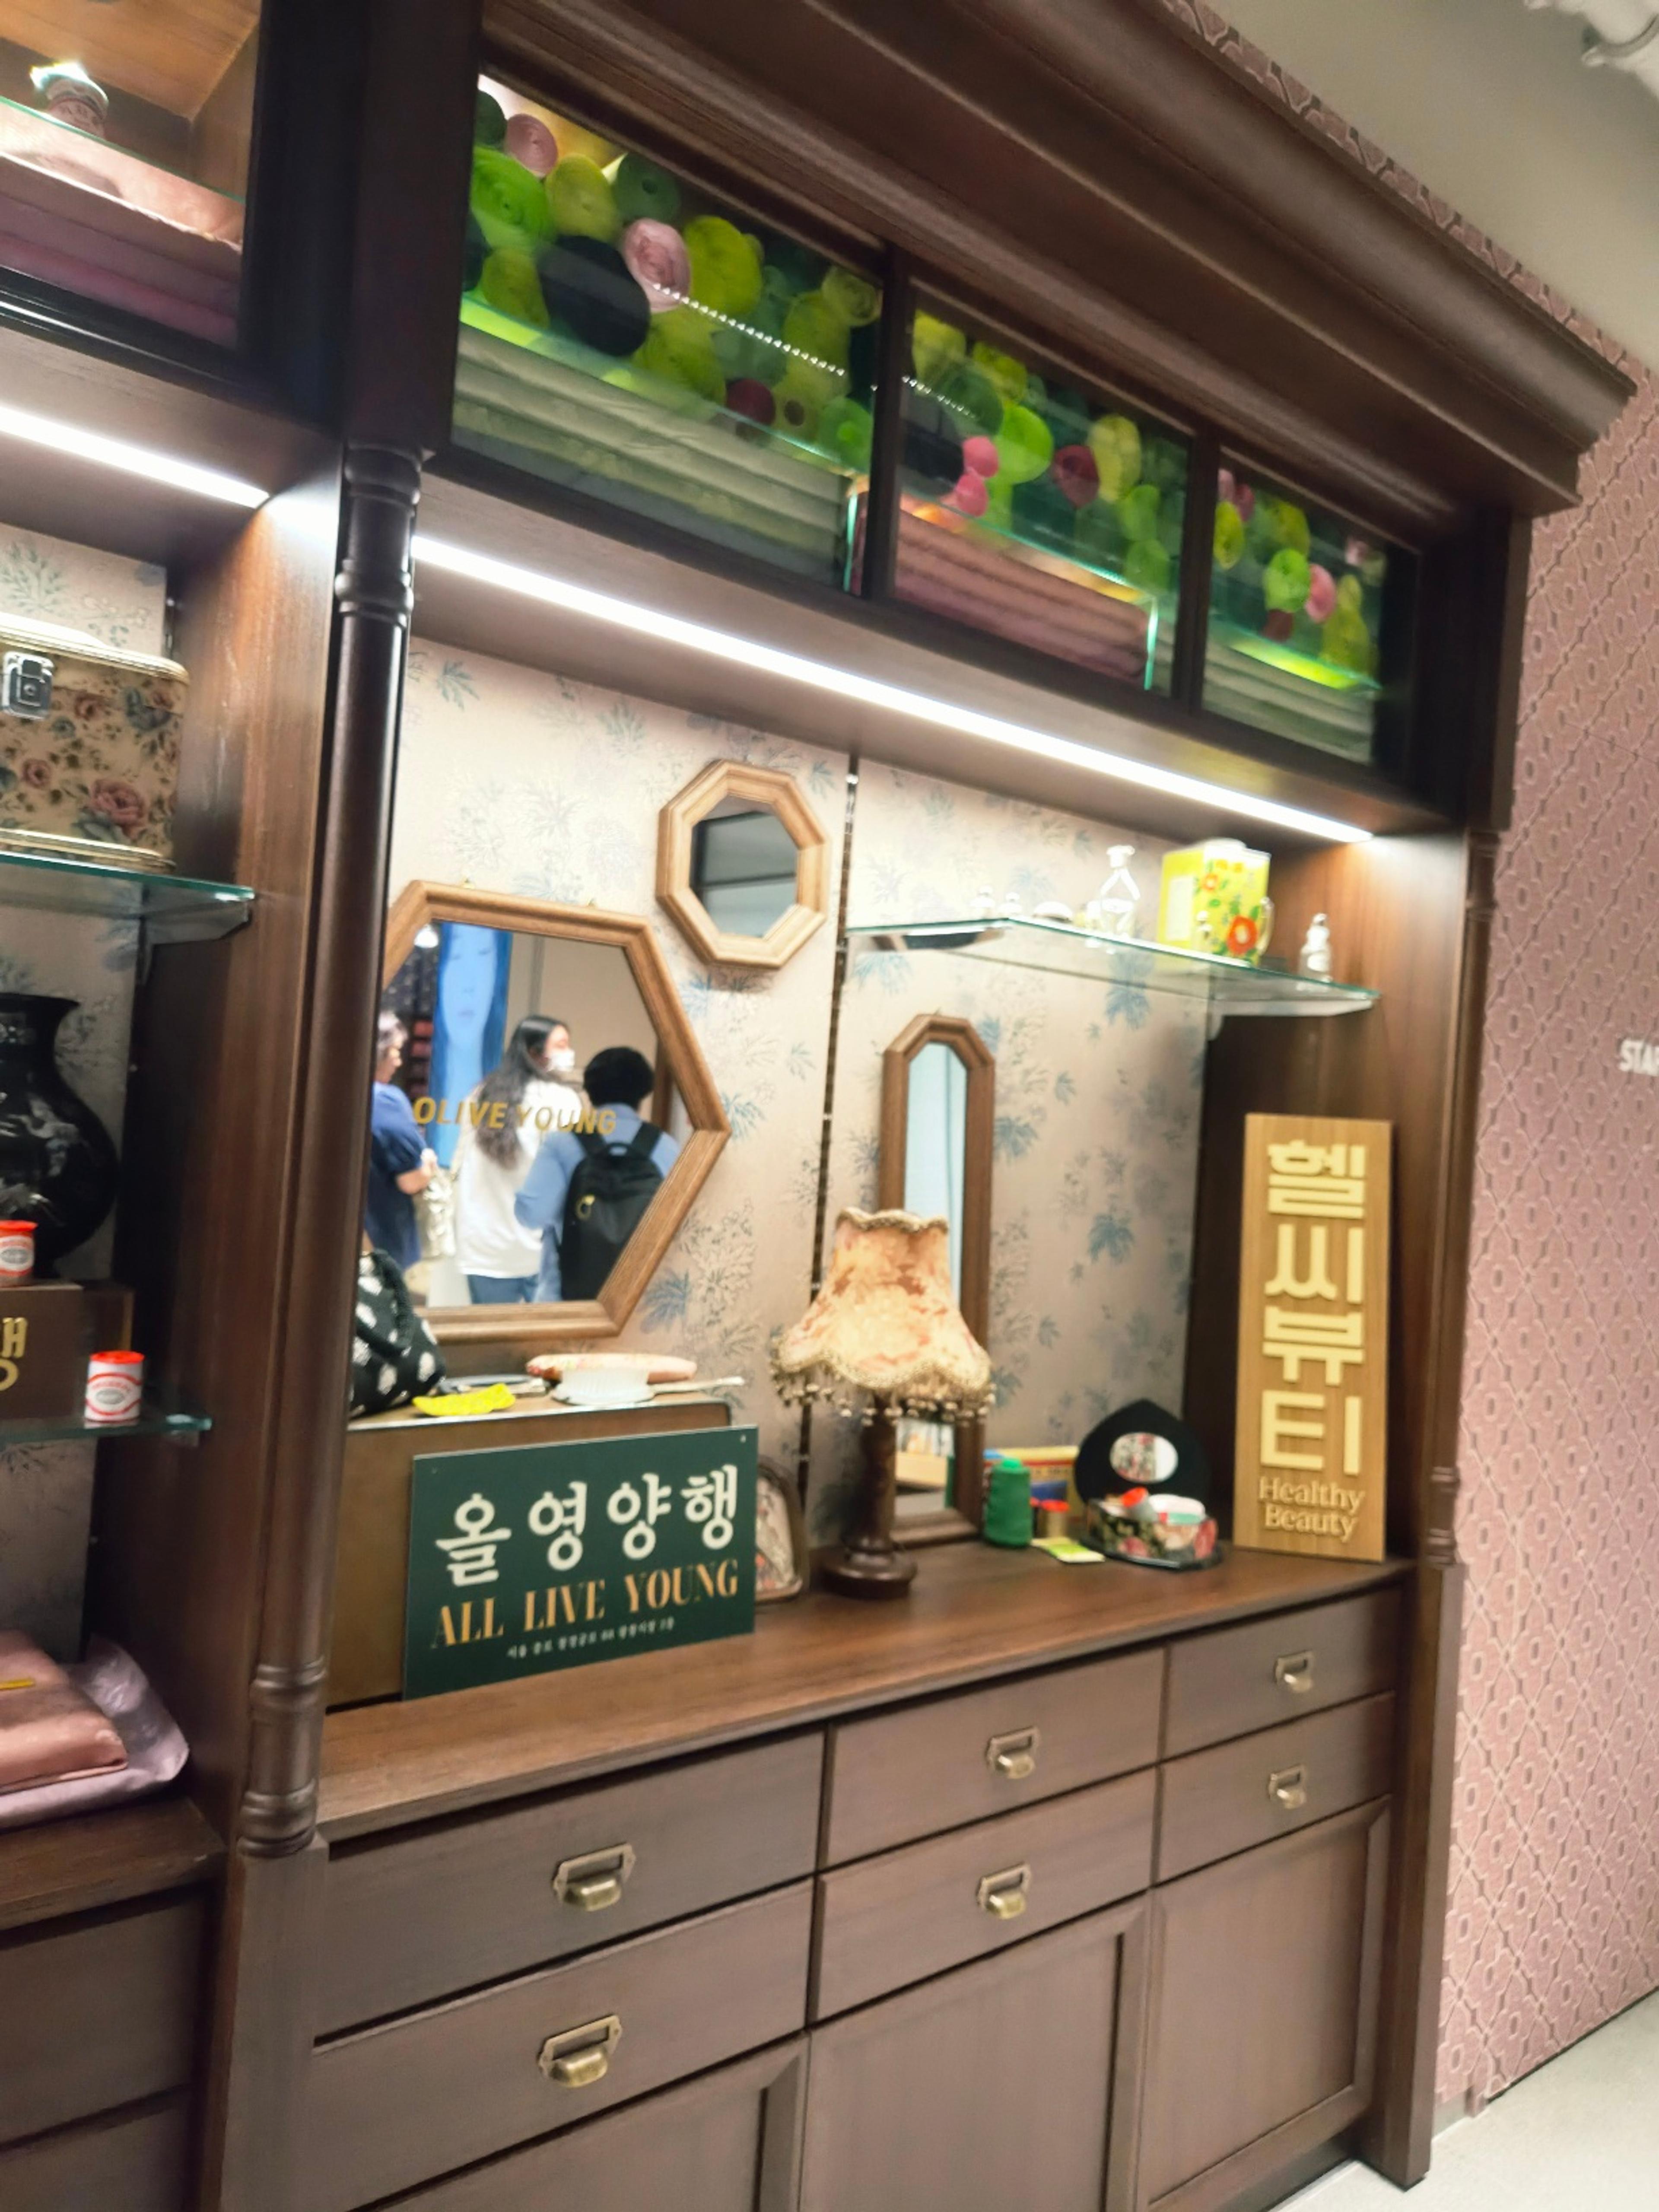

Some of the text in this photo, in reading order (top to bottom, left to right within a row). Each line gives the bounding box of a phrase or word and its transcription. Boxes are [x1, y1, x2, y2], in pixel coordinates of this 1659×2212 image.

[1619, 1039, 1659, 1077] STA
[413, 1097, 617, 1135] OLIVE YOUNG
[1260, 1139, 1367, 1476] 헬씨뷰티
[1259, 1476, 1366, 1516] Healthy
[435, 1464, 737, 1587] 올영양행
[1265, 1502, 1358, 1543] Beauty
[431, 1597, 504, 1649] ALL
[524, 1579, 605, 1632] LIVE
[625, 1559, 738, 1614] YOUNG
